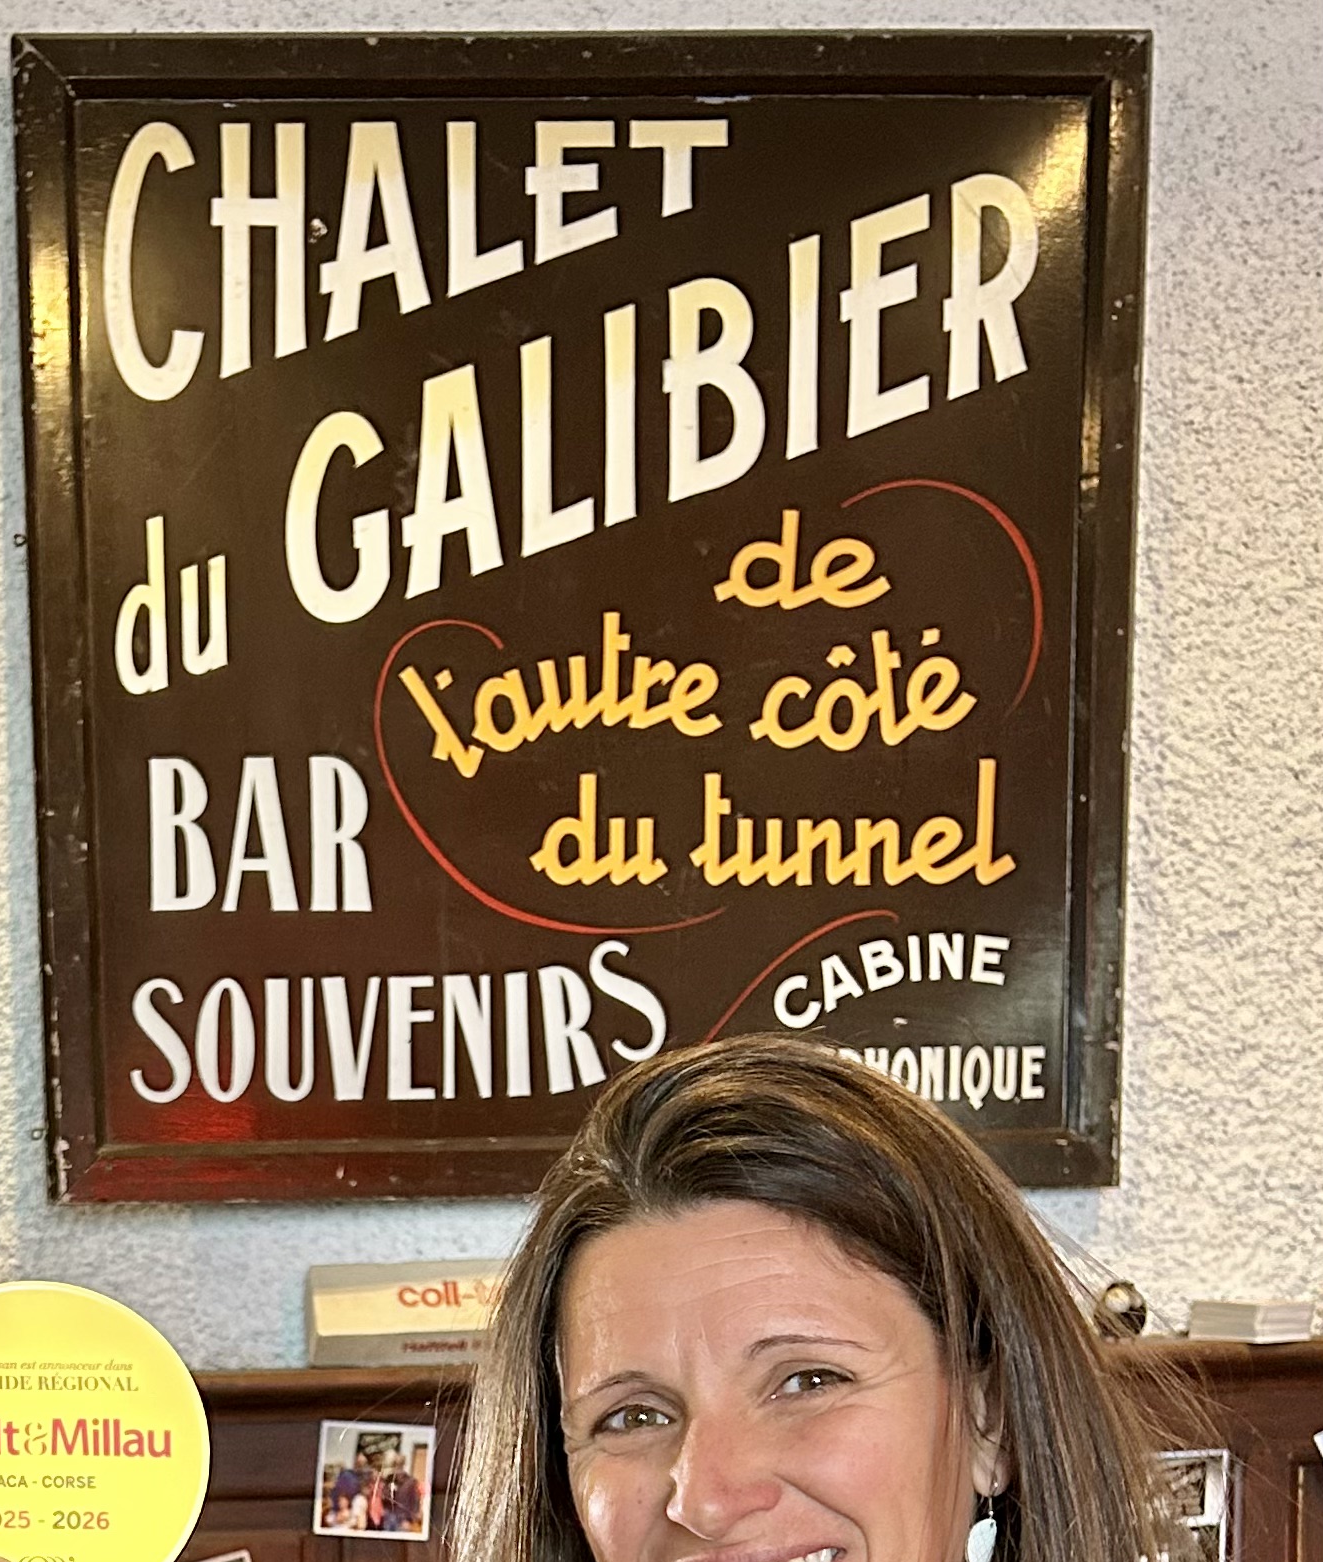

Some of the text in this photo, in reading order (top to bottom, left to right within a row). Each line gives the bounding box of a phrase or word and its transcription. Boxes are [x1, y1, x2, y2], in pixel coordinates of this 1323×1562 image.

[104, 121, 729, 402] CHALET
[115, 173, 1039, 695] du GALIBIER
[714, 510, 890, 610] de
[749, 628, 977, 752] côté
[149, 756, 374, 912] BAR
[530, 759, 1015, 887] du tunnel
[130, 941, 667, 1104] SOUVENIRS
[773, 932, 1011, 1029] CABINE
[838, 1045, 1046, 1110] HONIQUE
[20, 1360, 37, 1370] est
[39, 1361, 102, 1371] annonceur
[104, 1359, 133, 1371] dans
[38, 1372, 139, 1392] RÉGIONAL
[41, 1475, 96, 1489] CORSE
[52, 1511, 110, 1530] 2026
